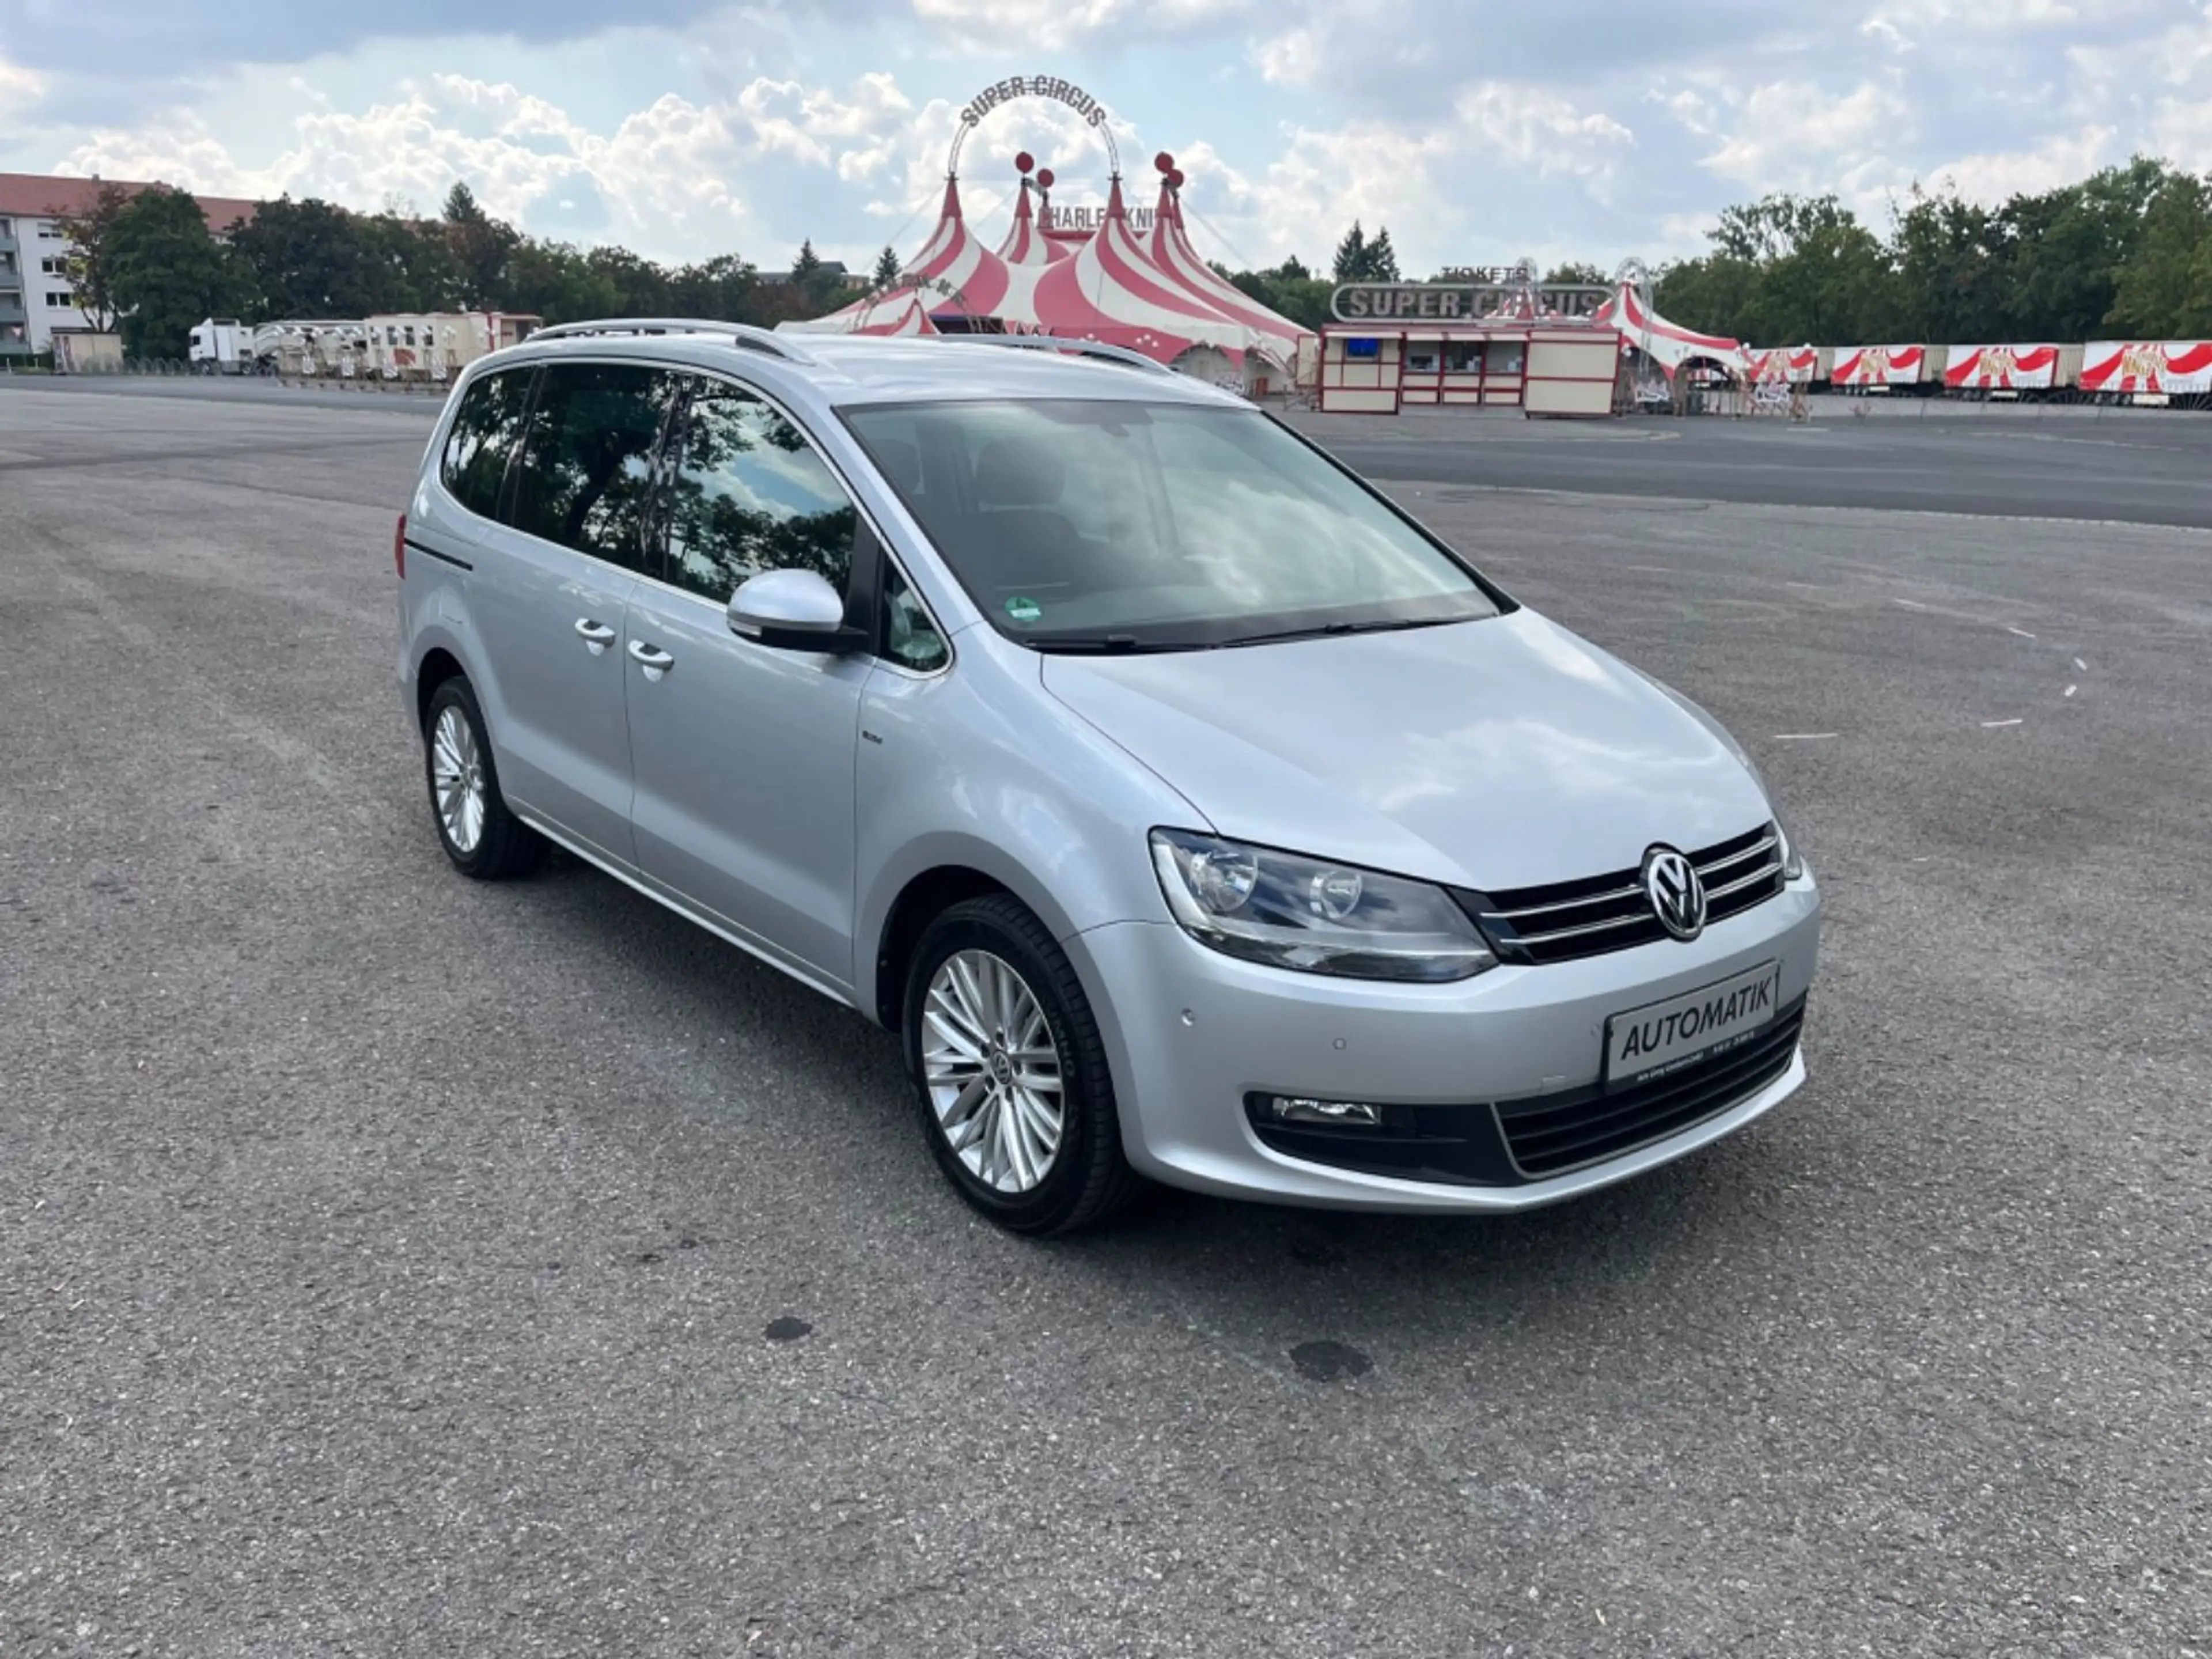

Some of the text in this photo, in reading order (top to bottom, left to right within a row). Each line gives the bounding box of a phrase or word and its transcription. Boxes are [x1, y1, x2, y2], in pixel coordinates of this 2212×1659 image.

[960, 74, 1107, 127] SUPER CIRCUS
[1039, 206, 1159, 228] HARLE KNI
[1441, 267, 1529, 284] TICKETS
[1349, 289, 1600, 317] SUPER CIRCUS
[1620, 976, 1772, 1060] AUTOMATIK
